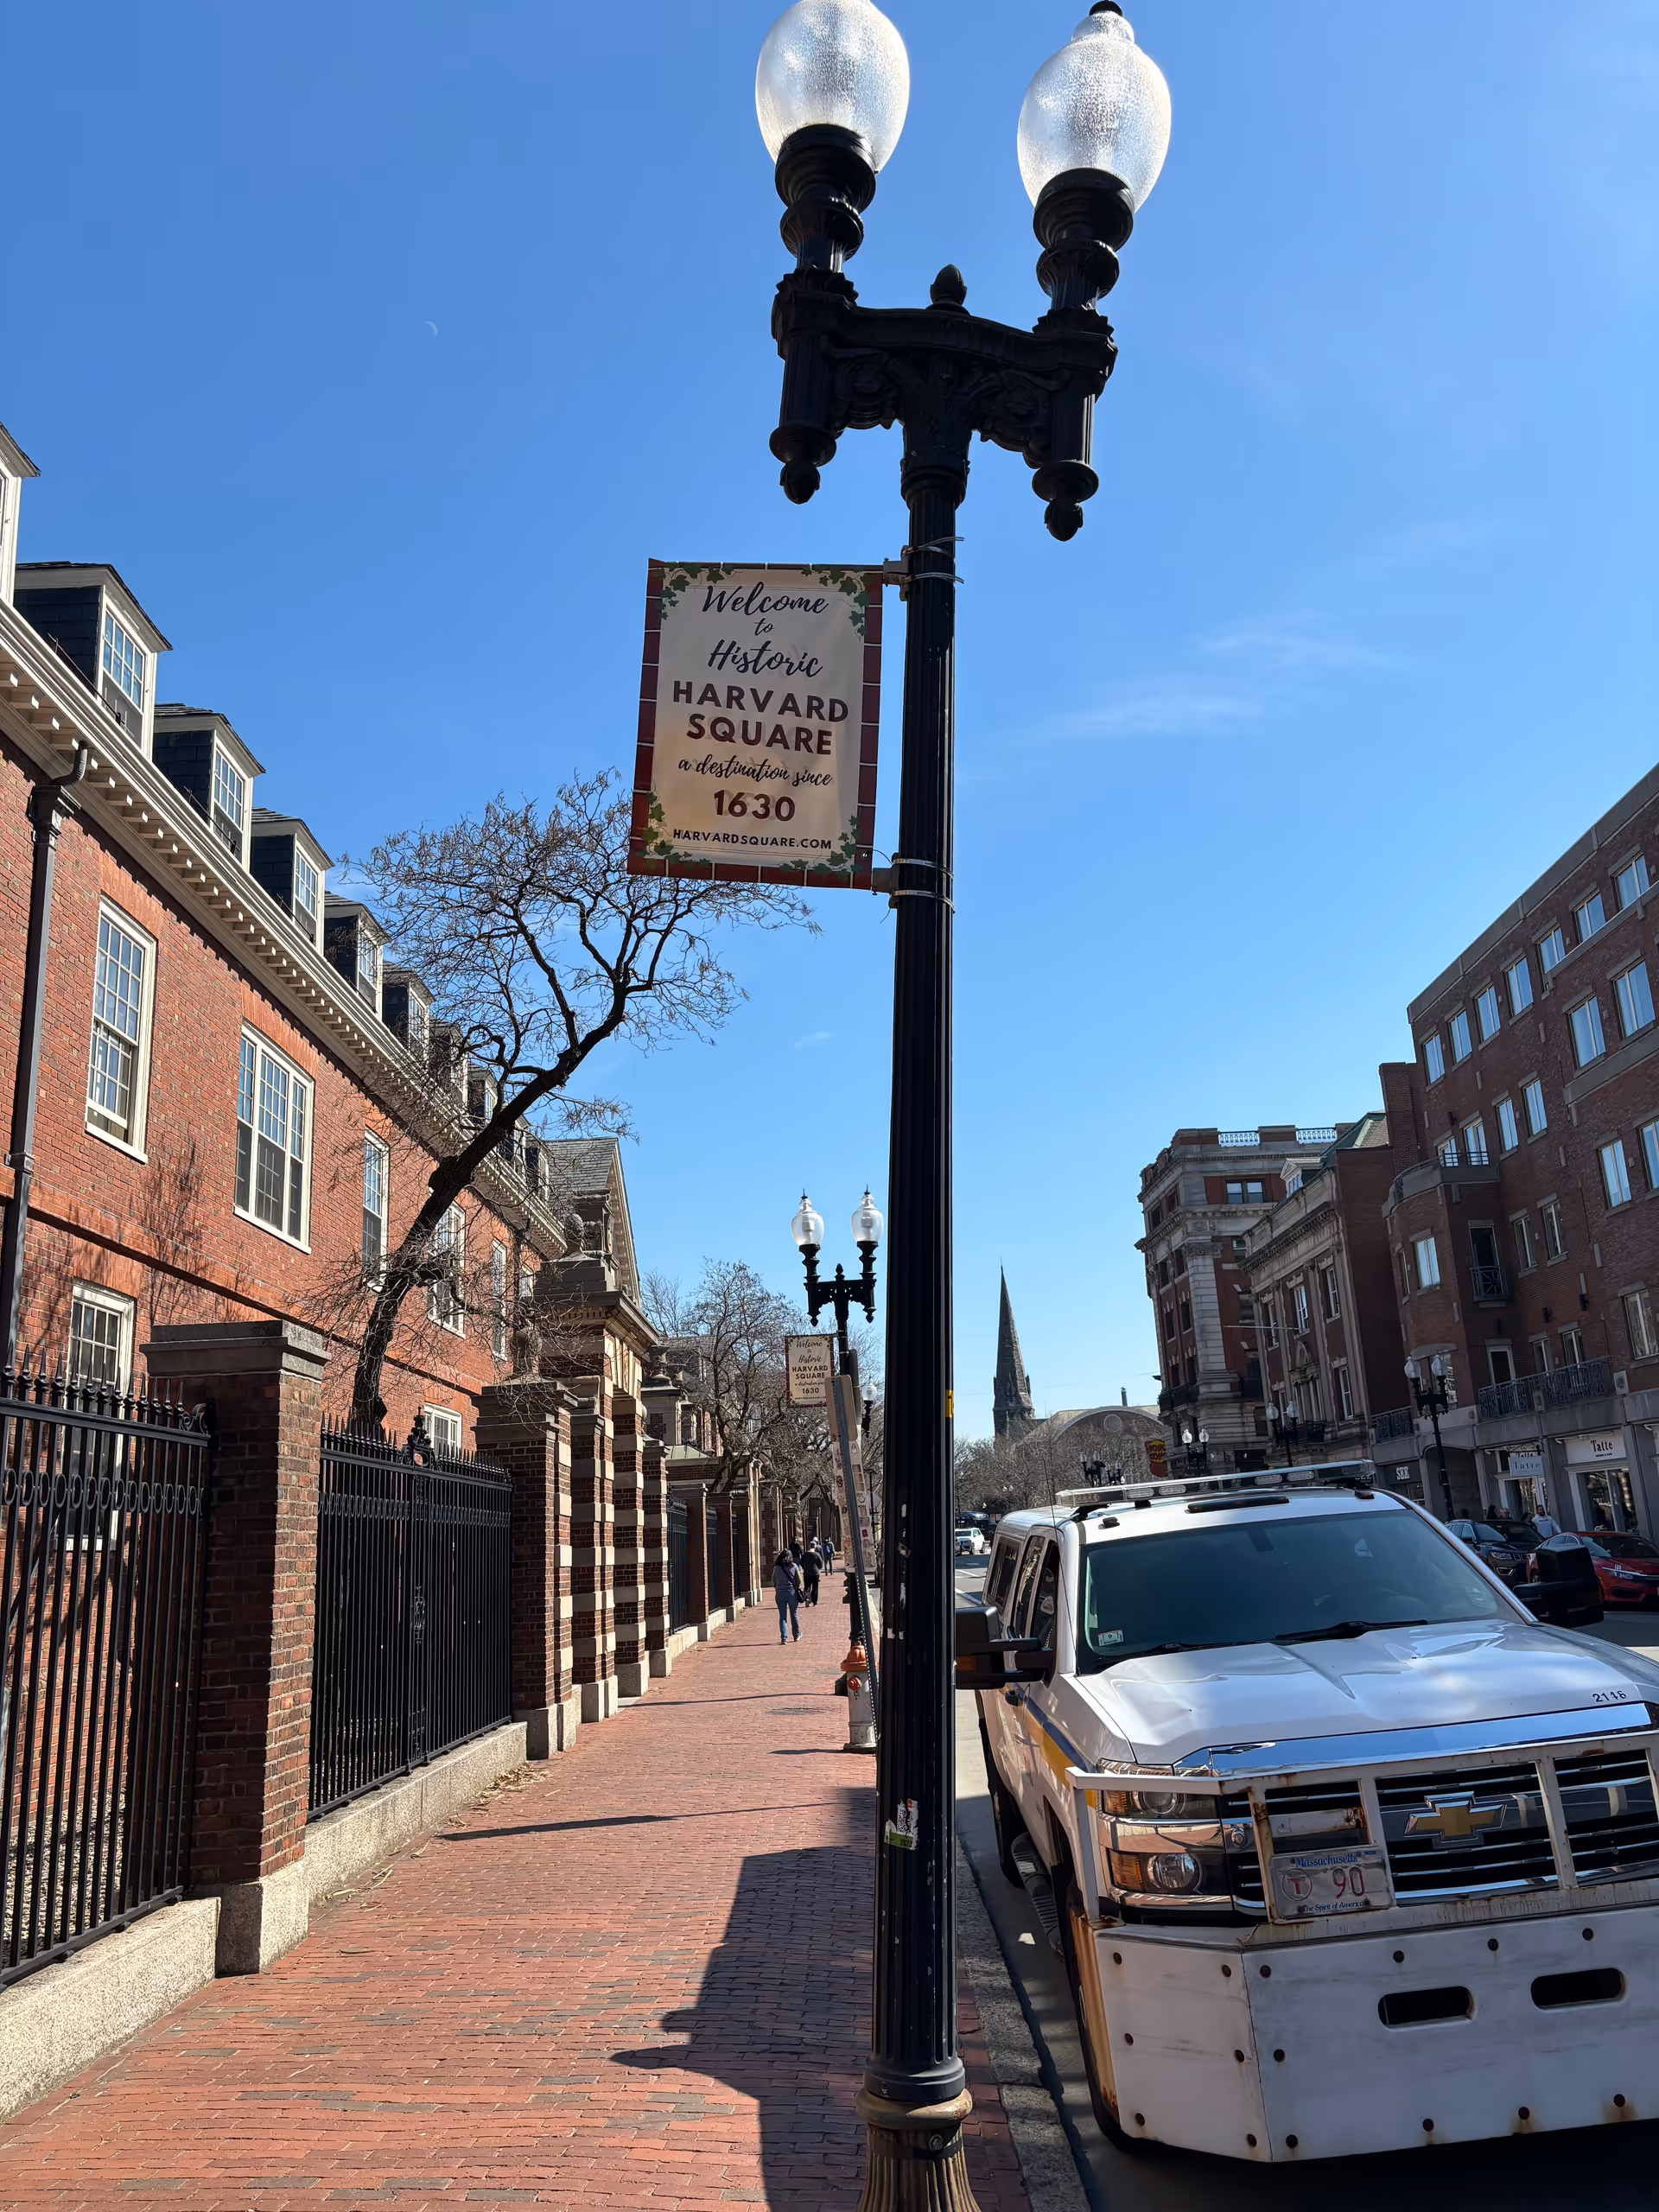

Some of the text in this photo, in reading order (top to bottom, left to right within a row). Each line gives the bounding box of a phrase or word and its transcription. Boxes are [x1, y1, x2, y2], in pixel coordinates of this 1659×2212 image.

[702, 581, 830, 615] Welcome
[753, 618, 775, 636] to
[708, 639, 823, 677] Historic
[673, 680, 849, 722] HARVARD
[686, 713, 833, 755] SQUARE
[677, 753, 833, 787] a destination since
[714, 789, 796, 822] 1630
[672, 829, 832, 849] HARVARDSQUARE.COM
[796, 1339, 823, 1348] Welcome
[798, 1355, 823, 1363] Historic
[1591, 1440, 1613, 1452] Tatte
[1395, 1466, 1410, 1480] SEE
[1511, 1461, 1541, 1470] Tatte
[1295, 1853, 1358, 1868] Massachusetts
[1332, 1866, 1365, 1899] 90
[1314, 1904, 1331, 1912] Spirit
[1338, 1901, 1364, 1910] America
